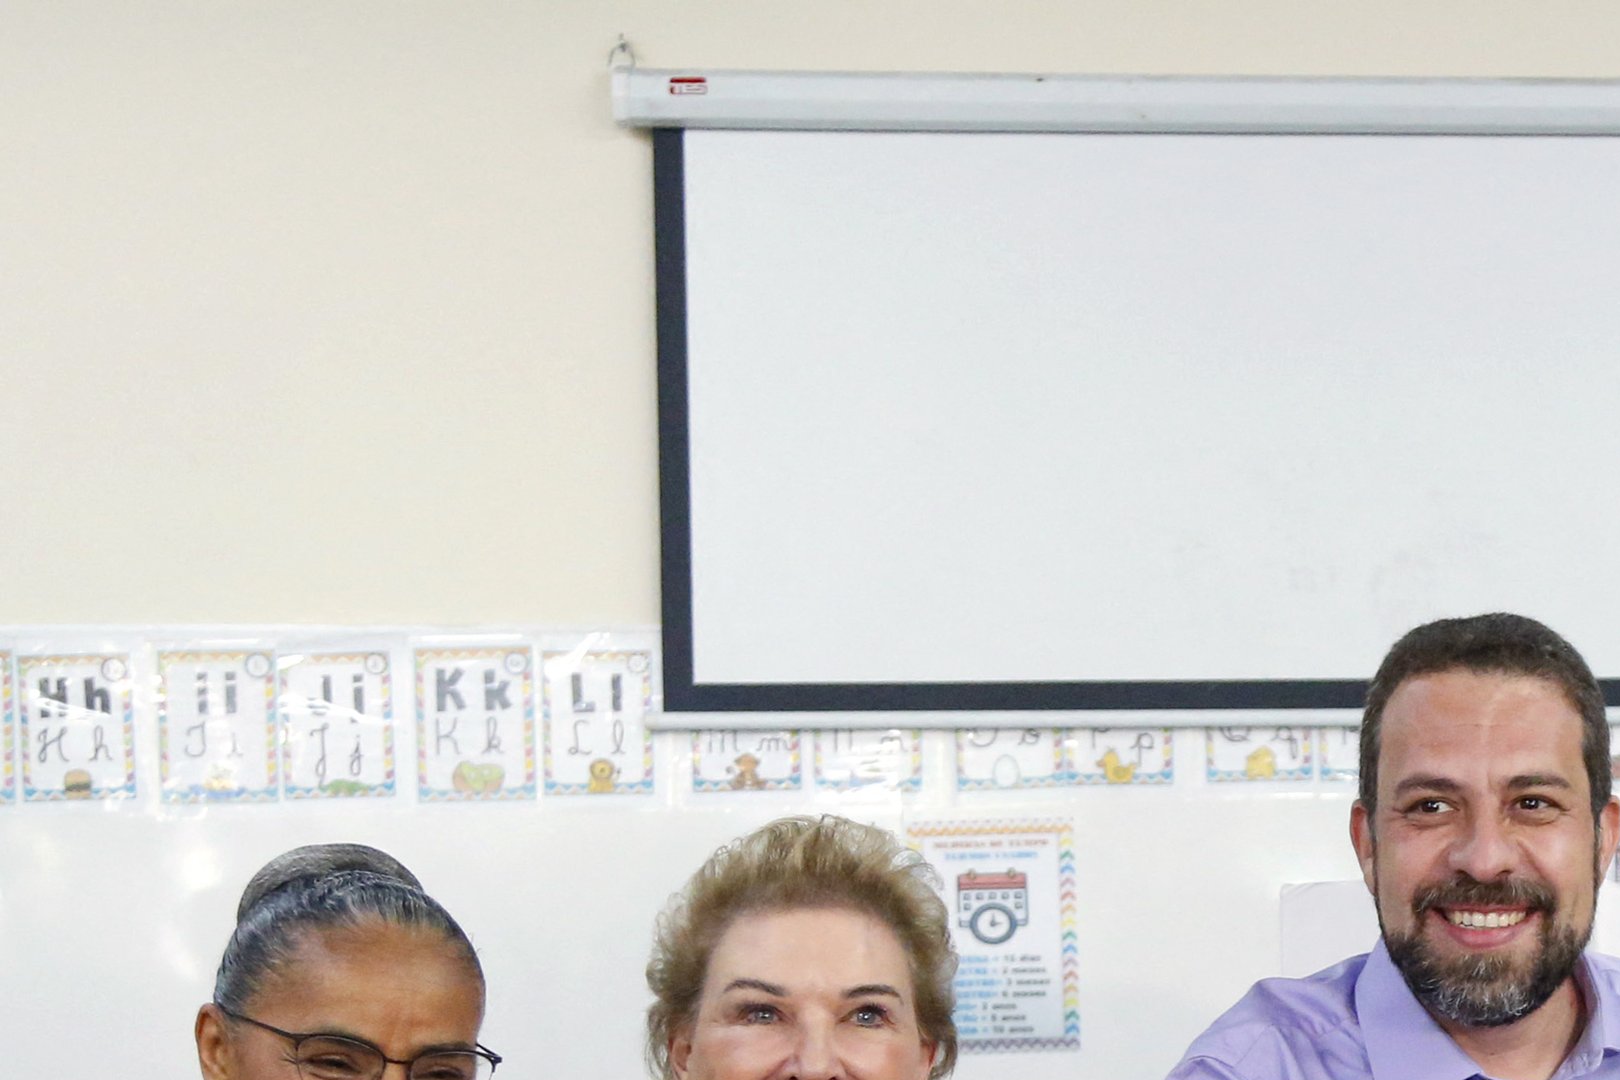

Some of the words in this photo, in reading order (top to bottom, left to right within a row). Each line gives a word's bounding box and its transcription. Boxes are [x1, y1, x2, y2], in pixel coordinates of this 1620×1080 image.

[84, 676, 111, 715] h
[435, 668, 466, 713] K
[484, 668, 513, 712] k
[571, 672, 596, 713] L
[434, 716, 462, 755] K
